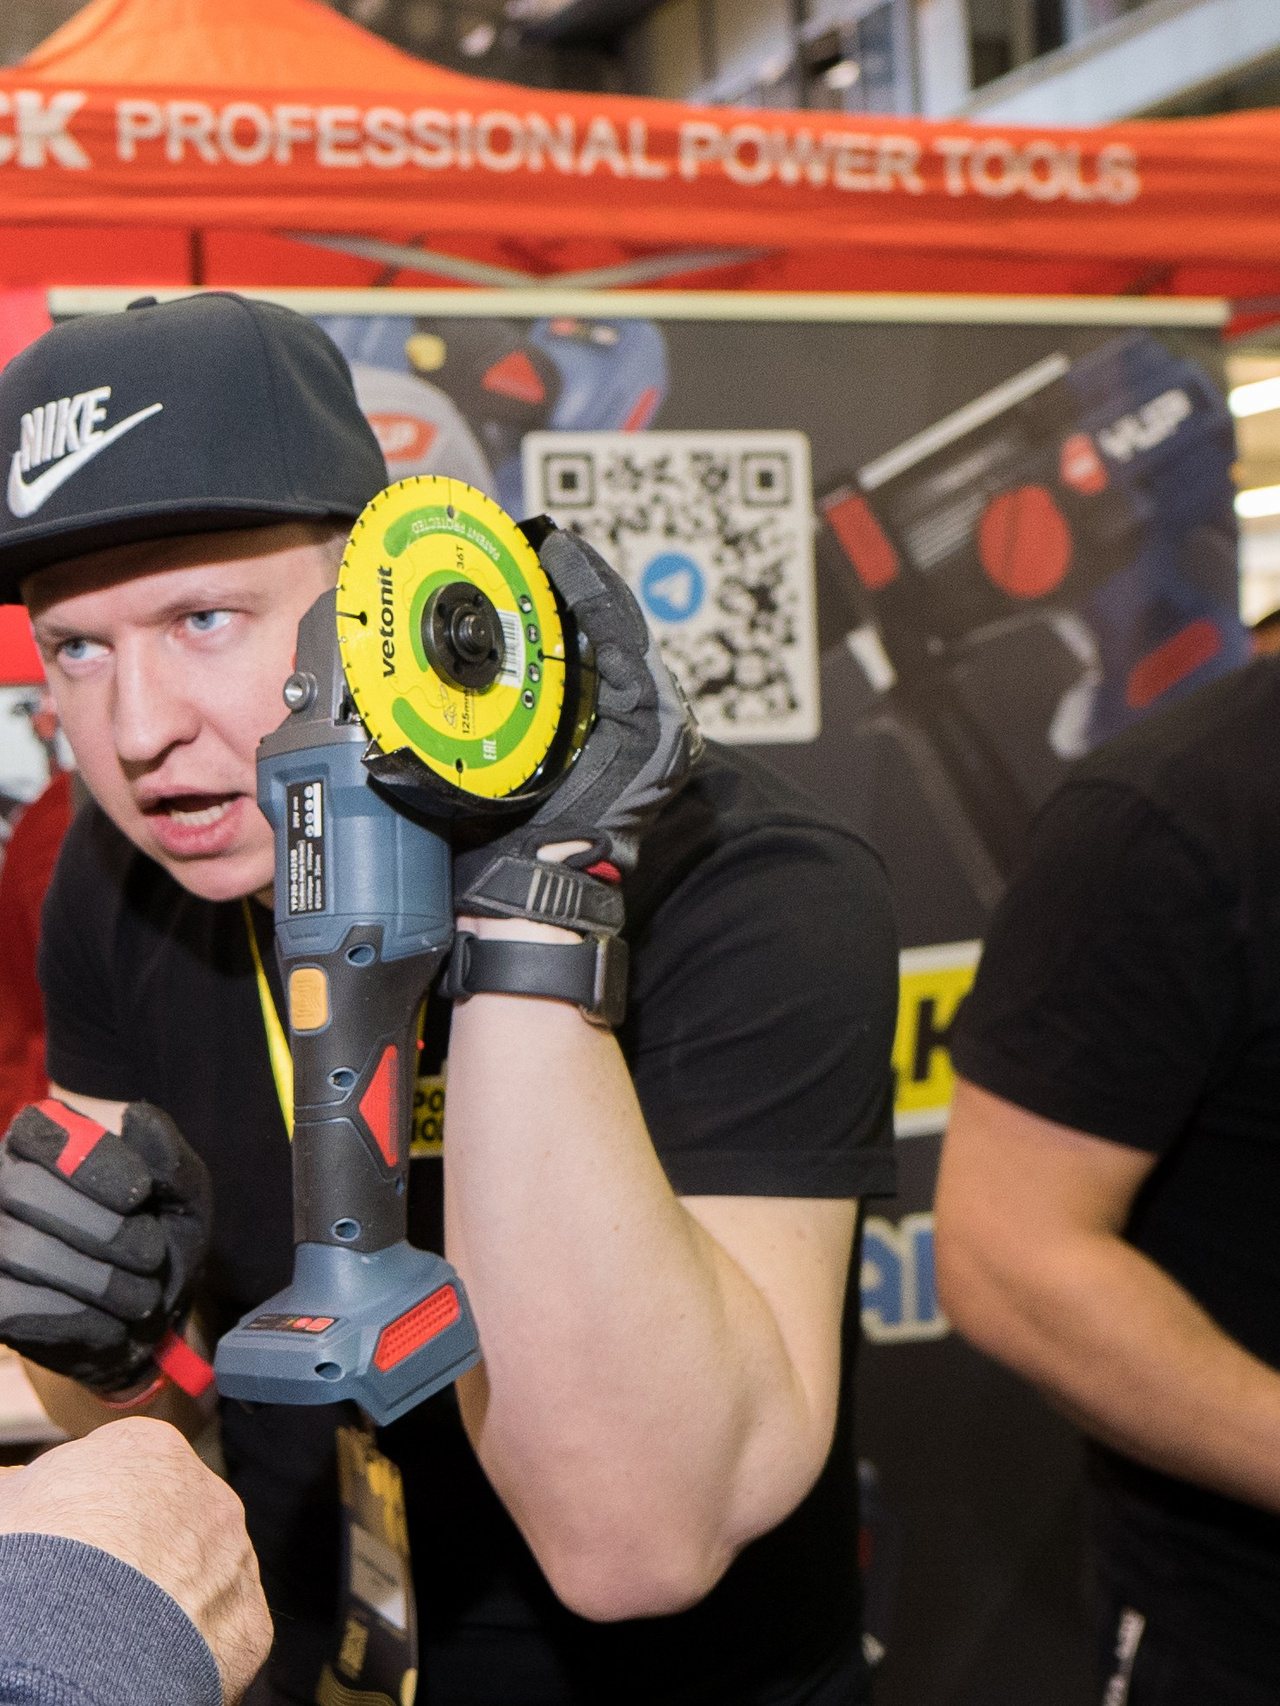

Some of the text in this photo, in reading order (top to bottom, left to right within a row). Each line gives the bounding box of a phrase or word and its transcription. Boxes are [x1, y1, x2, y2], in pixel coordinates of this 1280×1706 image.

[116, 99, 669, 180] PROFESSIONAL
[678, 120, 926, 195] POWER
[933, 135, 1142, 205] TOOLS
[20, 385, 112, 473] NIKE
[455, 544, 465, 570] 36T
[377, 565, 396, 678] vetonit
